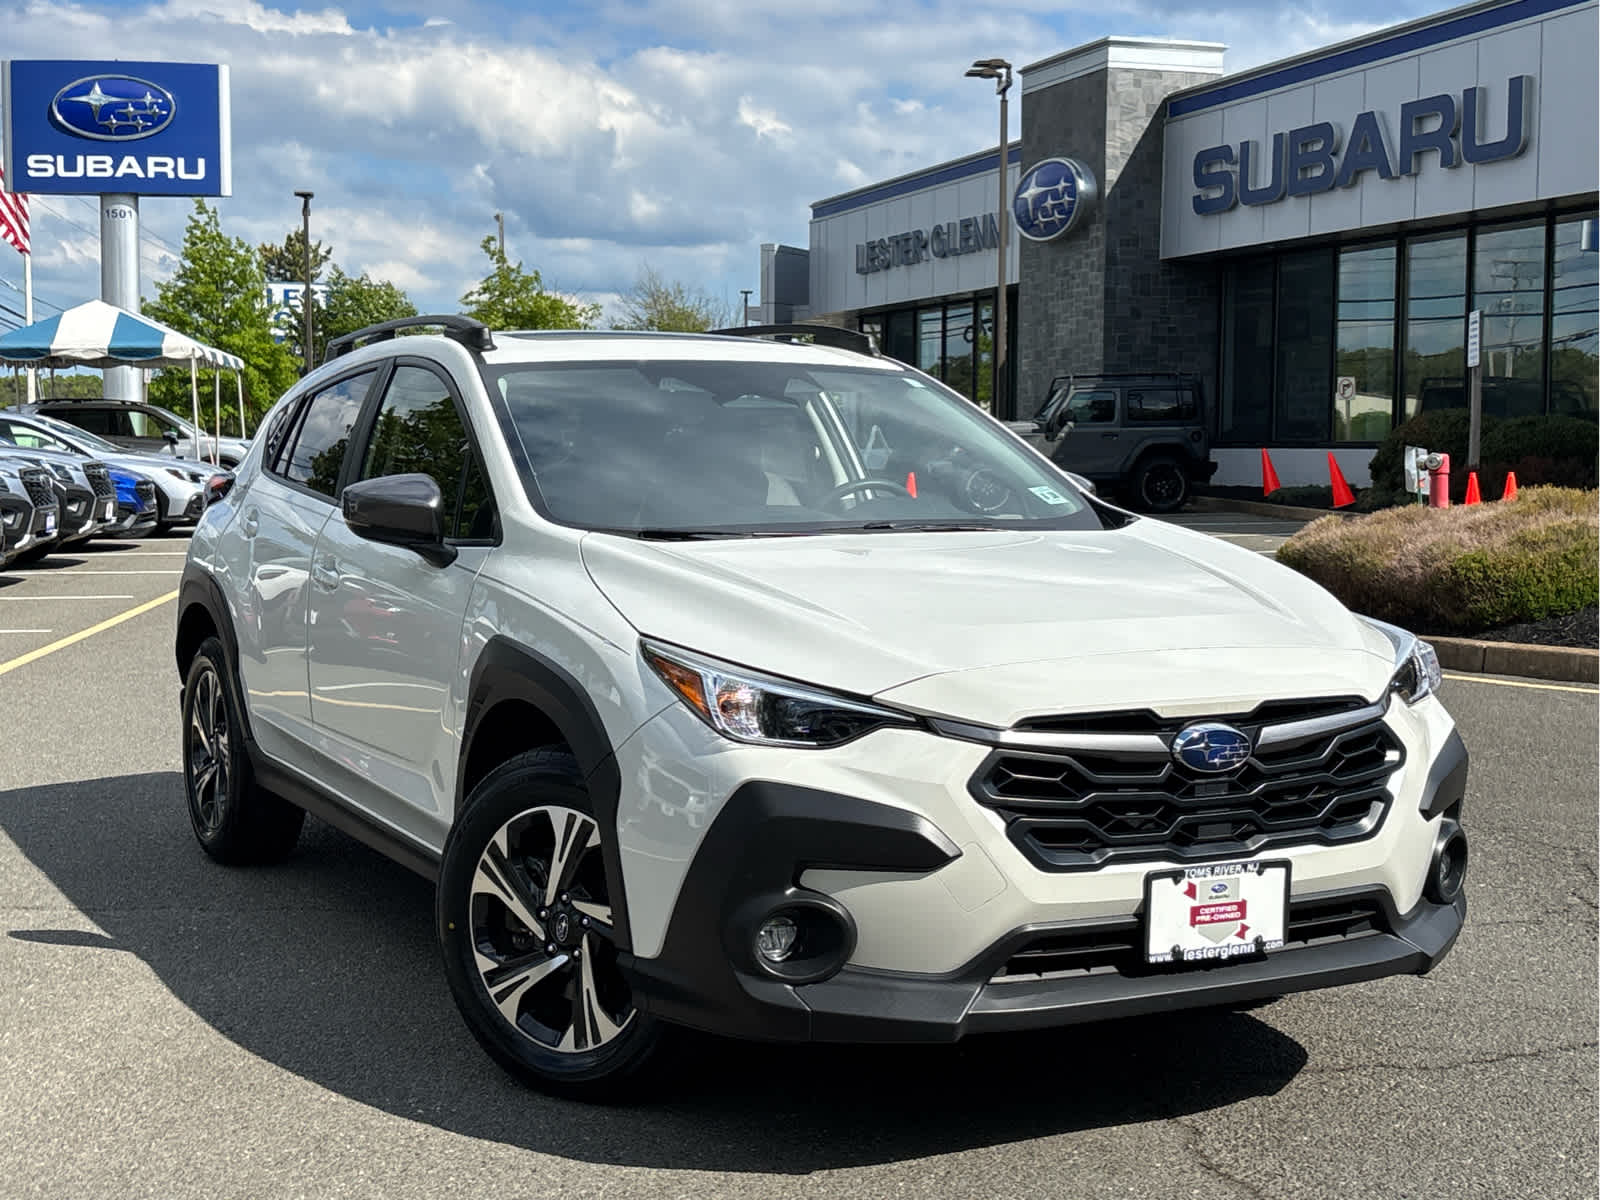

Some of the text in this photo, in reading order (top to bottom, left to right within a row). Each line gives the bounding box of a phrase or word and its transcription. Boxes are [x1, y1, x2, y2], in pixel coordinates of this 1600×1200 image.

[1192, 74, 1531, 216] SUBARU
[26, 154, 206, 180] SUBARU
[105, 208, 133, 219] 1501
[856, 212, 1003, 274] LESTER GLENN
[1184, 866, 1212, 879] TOMS
[1247, 861, 1260, 873] NJ
[1195, 911, 1242, 923] PRE-OWNED
[1199, 904, 1239, 915] CERTIFIED
